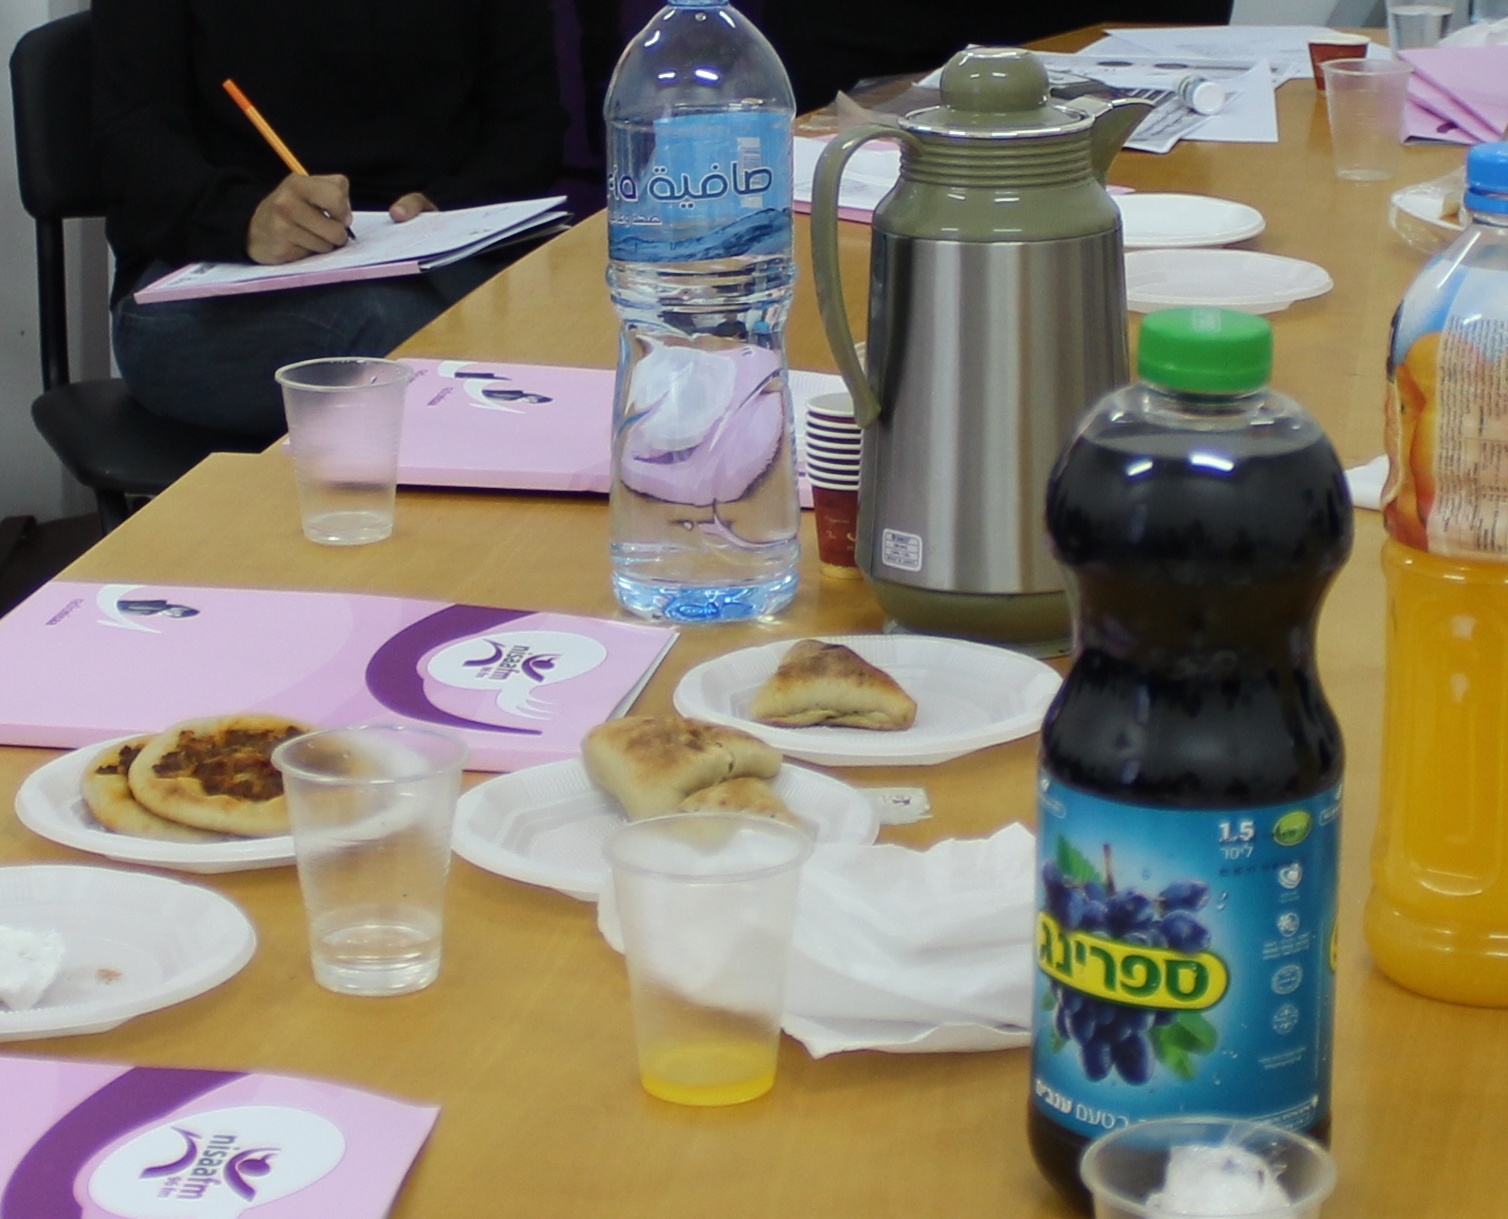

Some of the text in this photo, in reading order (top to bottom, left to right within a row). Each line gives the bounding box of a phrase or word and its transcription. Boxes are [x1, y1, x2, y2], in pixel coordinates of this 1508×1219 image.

[648, 161, 774, 209] صافية
[1219, 820, 1254, 842] 1.5
[176, 1134, 240, 1199] nisaafm
